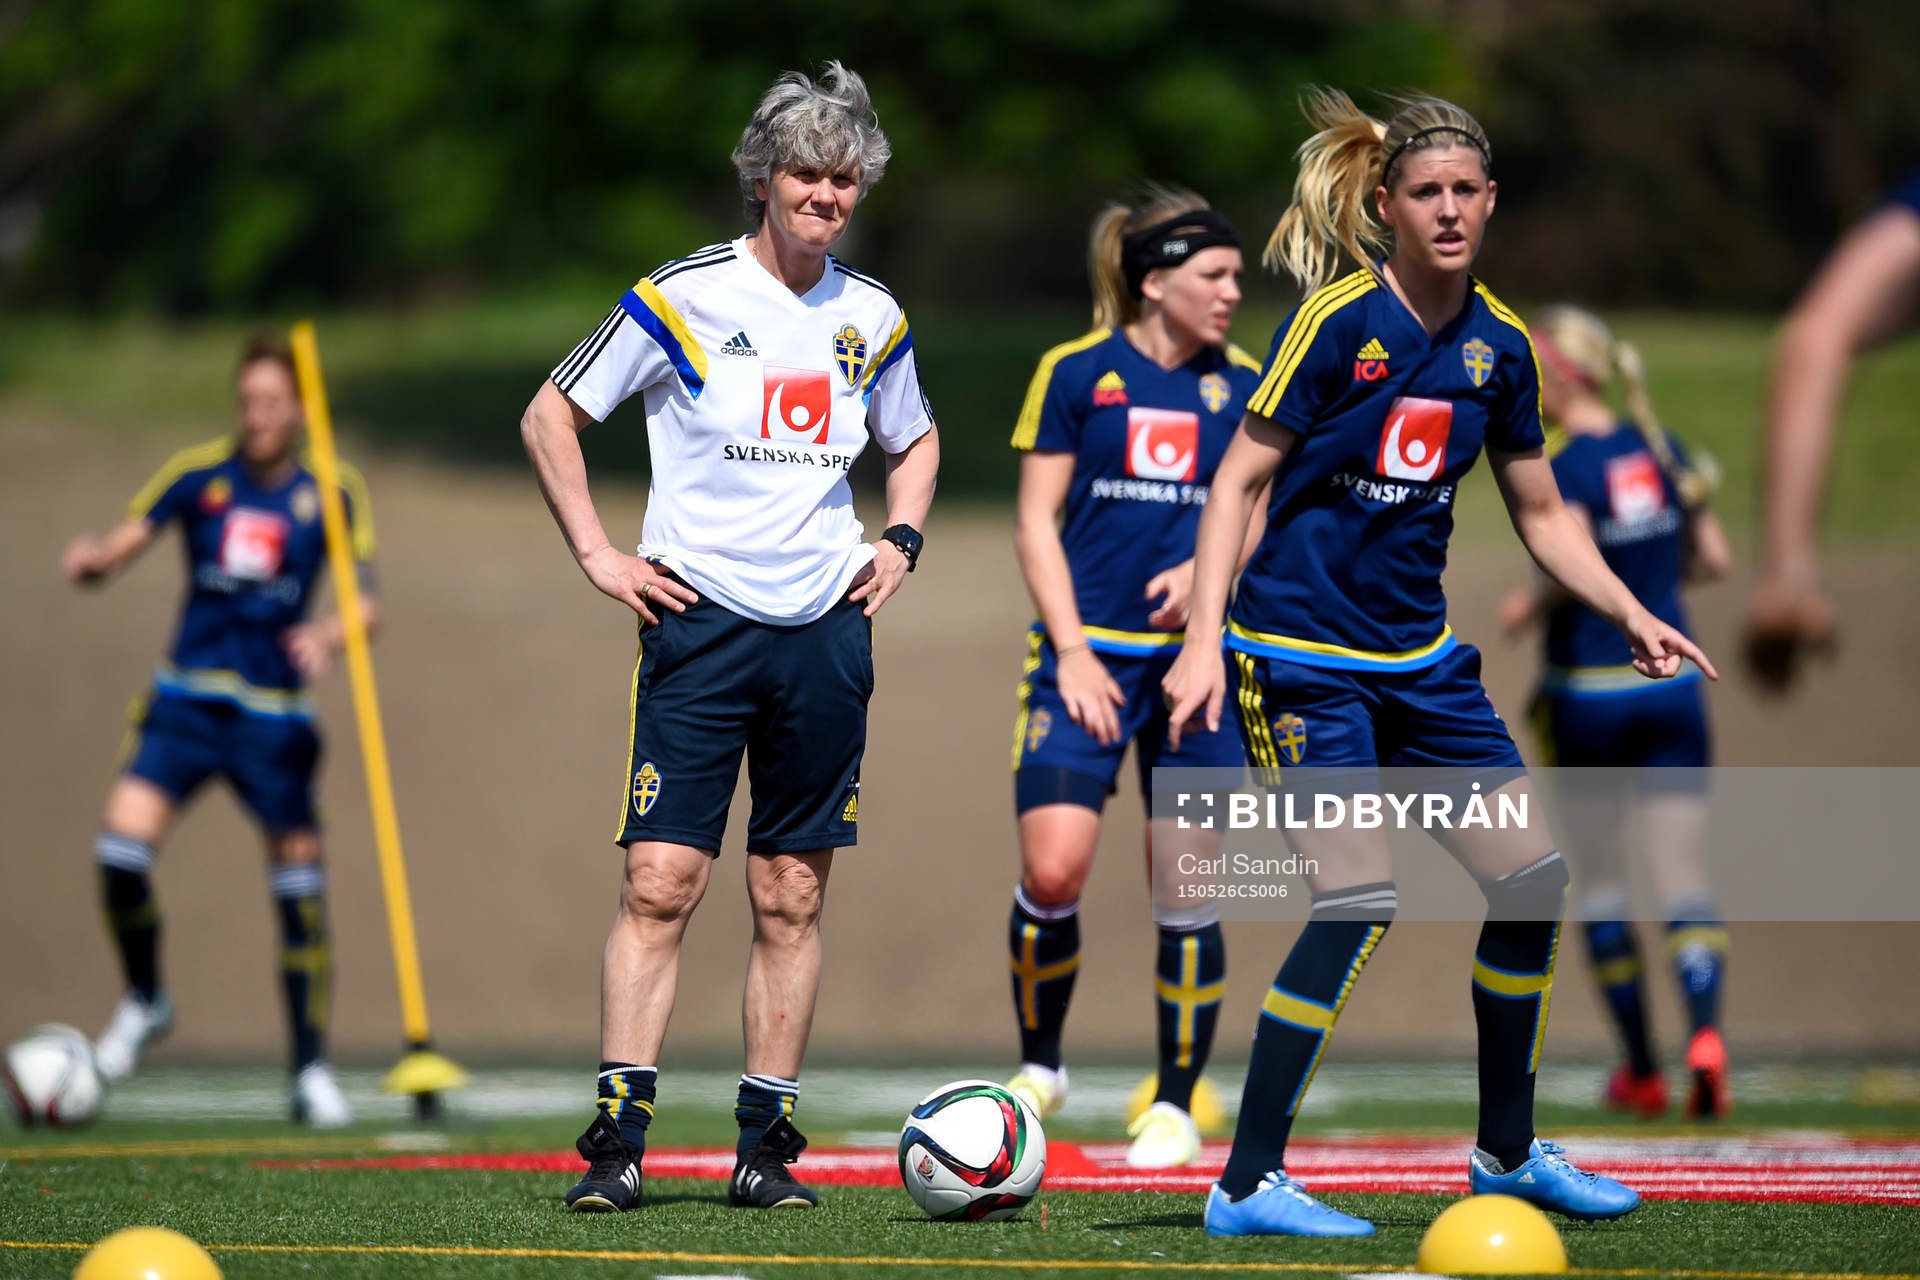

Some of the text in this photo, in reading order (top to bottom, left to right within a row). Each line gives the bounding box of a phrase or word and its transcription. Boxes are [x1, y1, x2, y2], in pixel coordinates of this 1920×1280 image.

[720, 345, 758, 357] adidas
[1354, 360, 1389, 382] ICA
[724, 444, 851, 472] SVENSKA SPE
[1330, 472, 1412, 504] SVENSK
